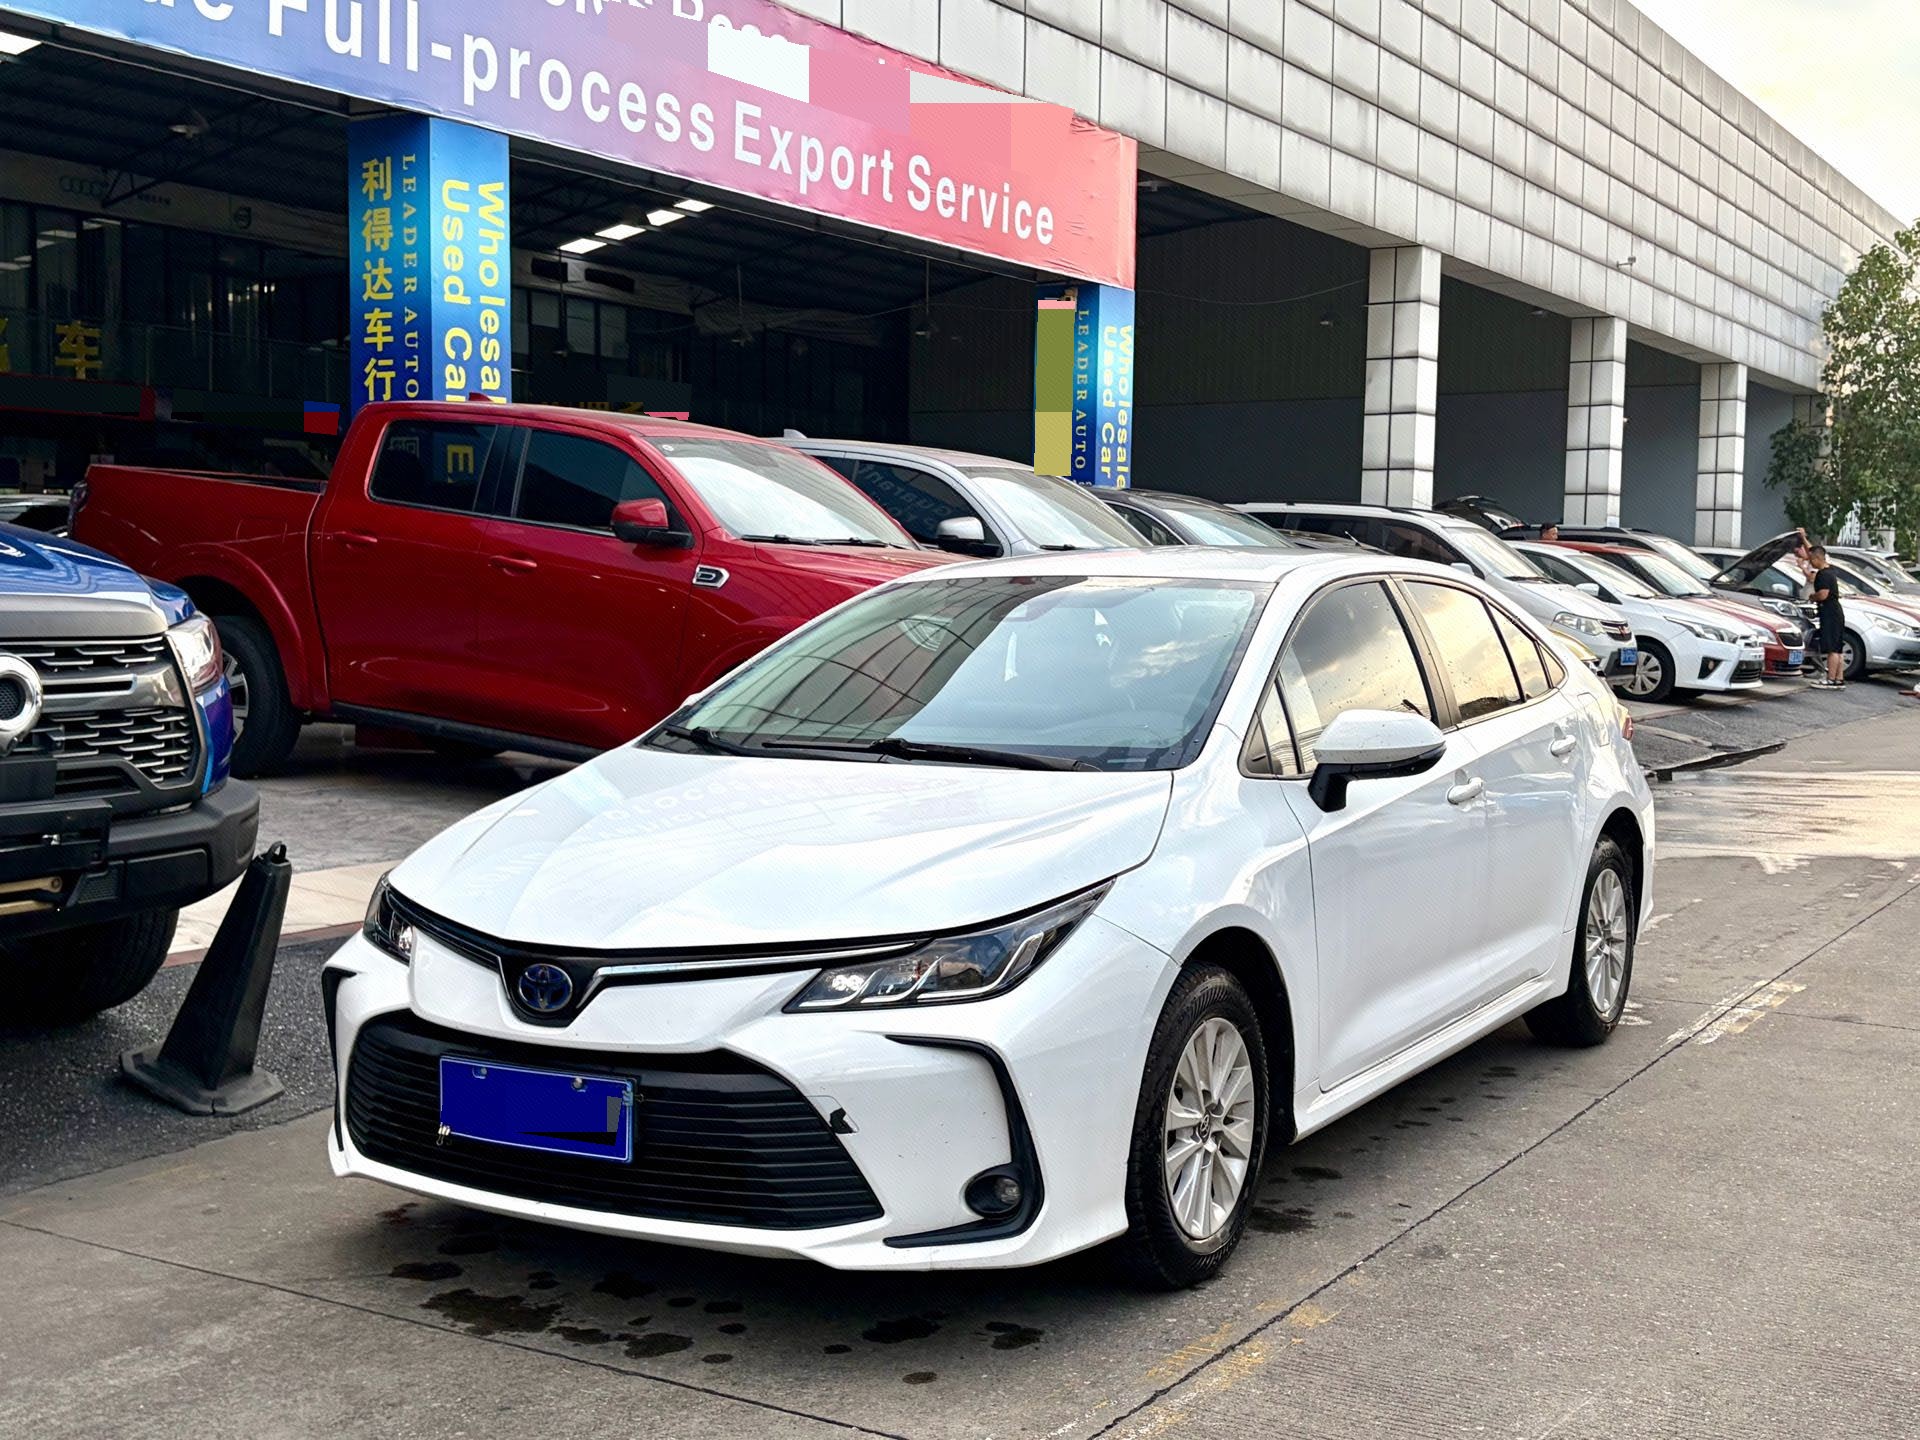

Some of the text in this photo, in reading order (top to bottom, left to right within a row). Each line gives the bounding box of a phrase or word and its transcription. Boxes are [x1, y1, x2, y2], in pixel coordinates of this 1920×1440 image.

[441, 179, 471, 305] Used
[734, 100, 894, 202] Export
[907, 154, 1054, 245] Service
[362, 156, 396, 402] 利得达车行
[402, 153, 420, 398] LEADER AUTO
[1076, 310, 1090, 401] LEADER
[1101, 326, 1117, 479] Used Car
[1116, 325, 1132, 490] Wholesale
[1075, 409, 1087, 469] AUTO
